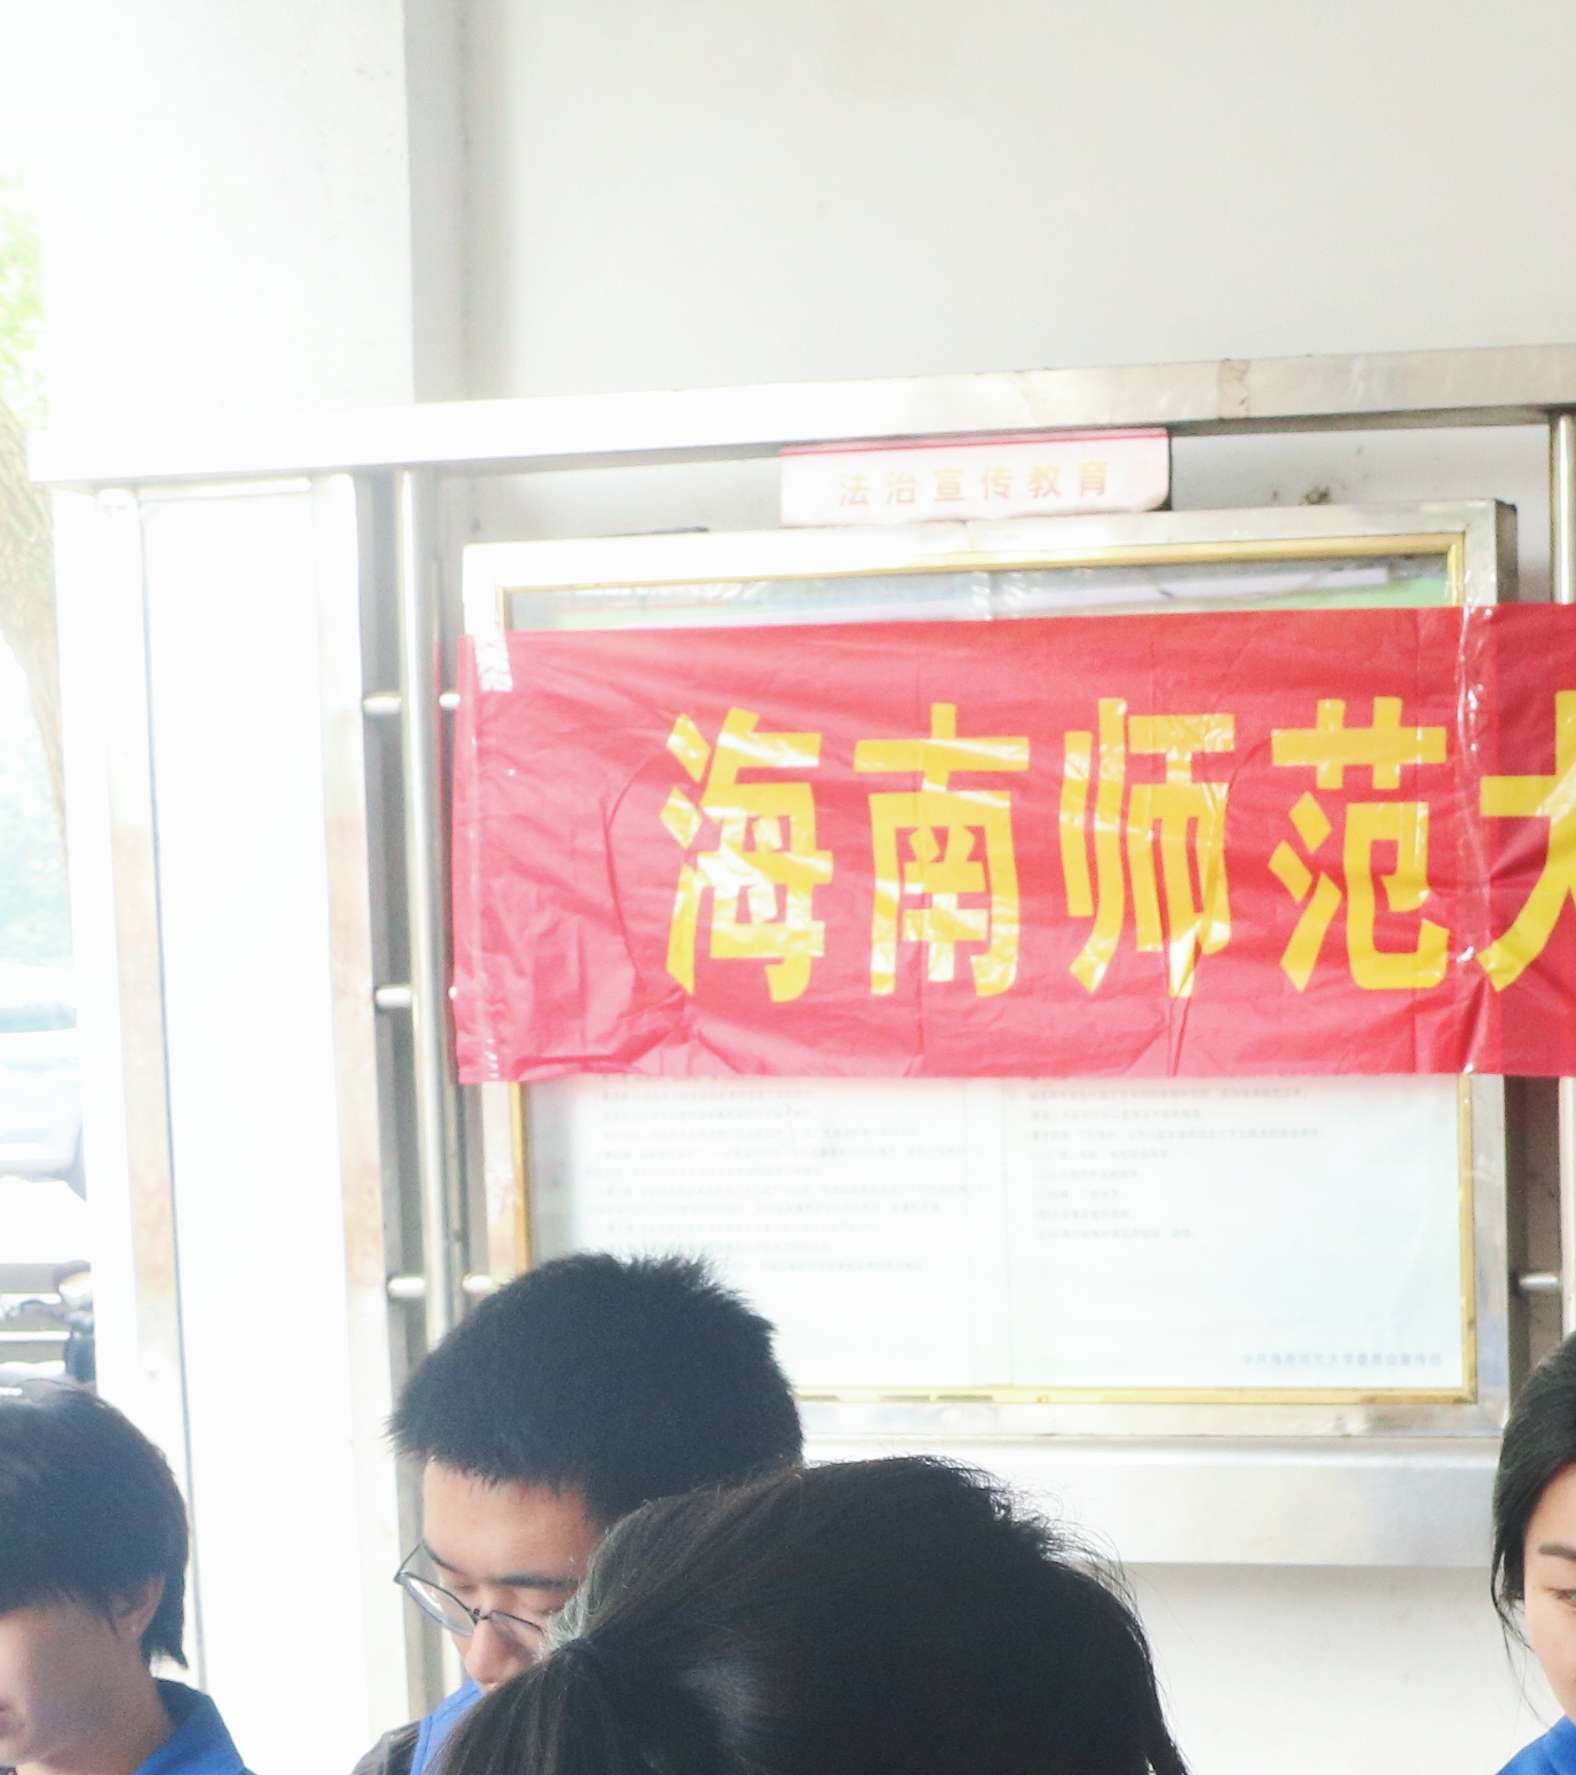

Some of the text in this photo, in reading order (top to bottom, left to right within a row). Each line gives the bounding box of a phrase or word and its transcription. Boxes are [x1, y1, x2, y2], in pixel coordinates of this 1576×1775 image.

[839, 460, 1110, 505] 法治宣传教育
